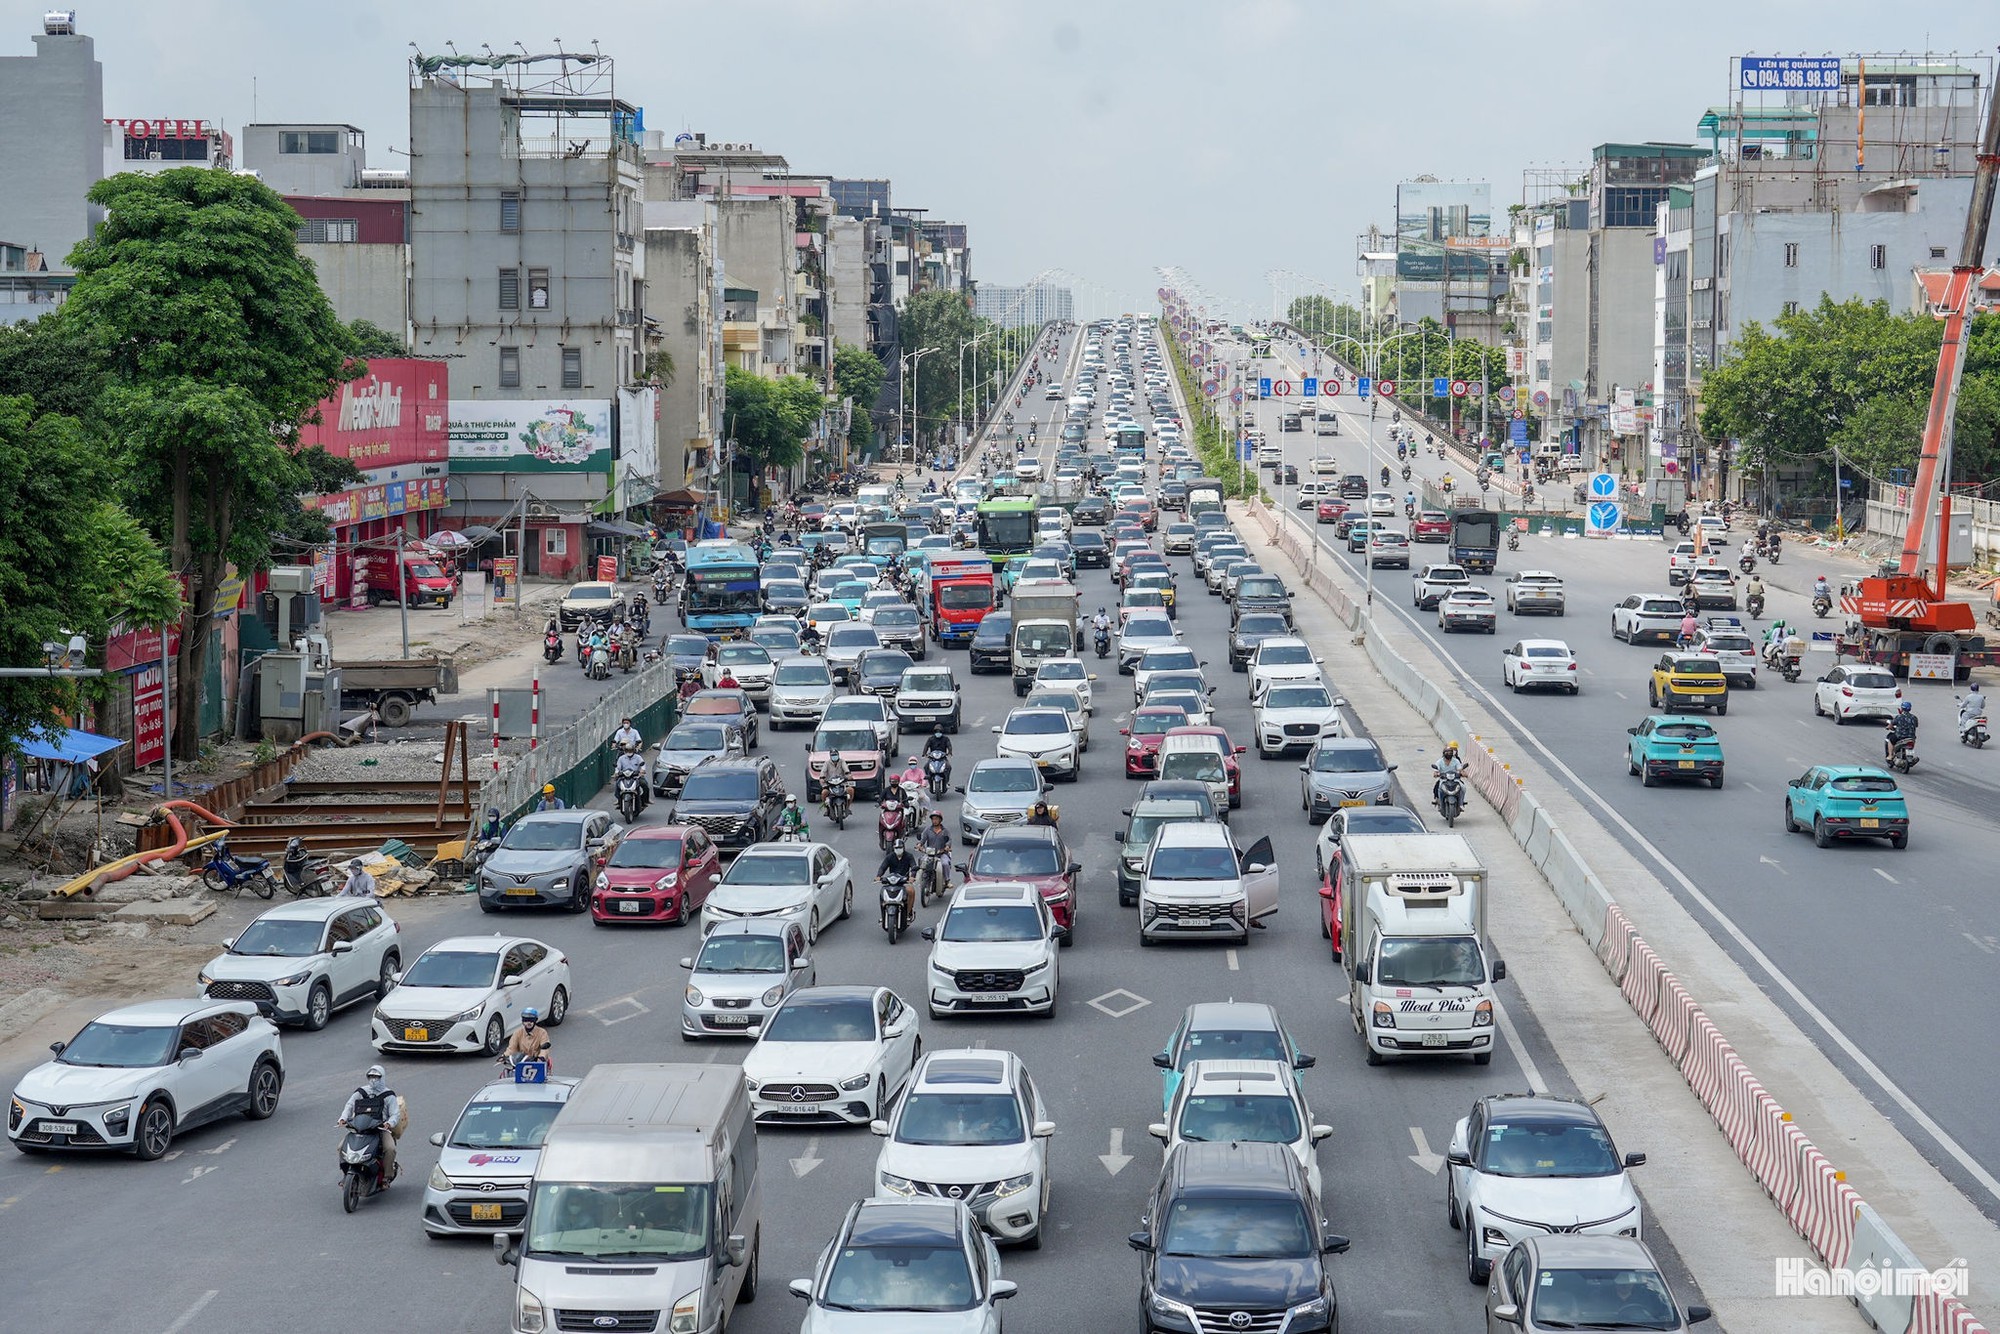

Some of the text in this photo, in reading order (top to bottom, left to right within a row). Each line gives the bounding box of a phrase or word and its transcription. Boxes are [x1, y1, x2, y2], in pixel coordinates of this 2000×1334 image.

[1780, 60, 1790, 69] HỆ
[1792, 60, 1820, 68] QUẢNG
[1822, 60, 1838, 68] CÁO
[1759, 70, 1838, 87] 094.986.98.98
[1329, 384, 1336, 392] 60
[1383, 384, 1390, 392] 60
[1456, 384, 1464, 392] 40
[1400, 1000, 1465, 1012] Meat Plus
[522, 1065, 537, 1080] G7
